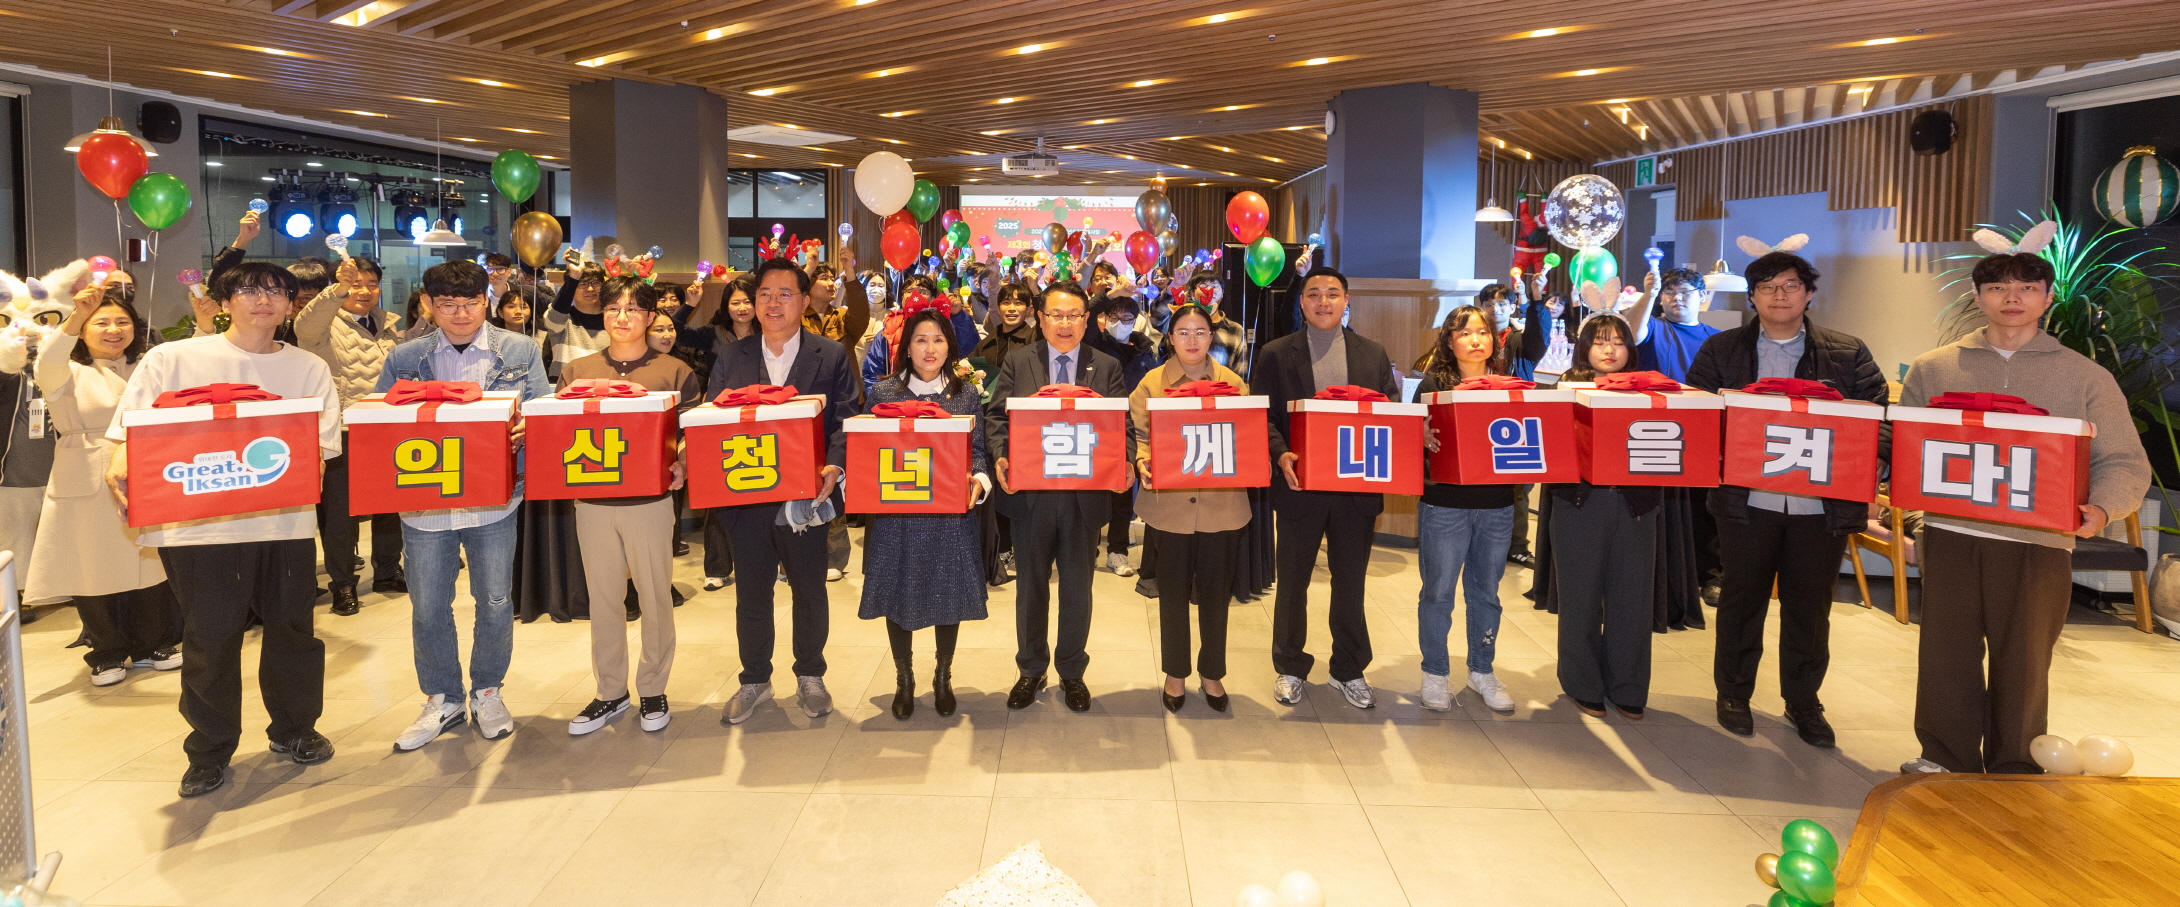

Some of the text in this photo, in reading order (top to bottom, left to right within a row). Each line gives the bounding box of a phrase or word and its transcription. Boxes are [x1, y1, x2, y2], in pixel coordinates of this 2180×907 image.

[998, 222, 1019, 230] 2025
[1007, 240, 1031, 249] 제3회
[394, 436, 463, 498] 익
[563, 427, 627, 486] 산
[721, 433, 780, 493] 청
[1041, 421, 1099, 478] 함
[1181, 422, 1237, 477] 께
[1337, 425, 1392, 482] 내
[1488, 417, 1547, 474] 일
[1627, 420, 1684, 475] 을
[1761, 424, 1834, 485] 켜
[188, 474, 251, 491] Iksan
[878, 447, 934, 504] 년
[1921, 438, 2037, 512] 다!
